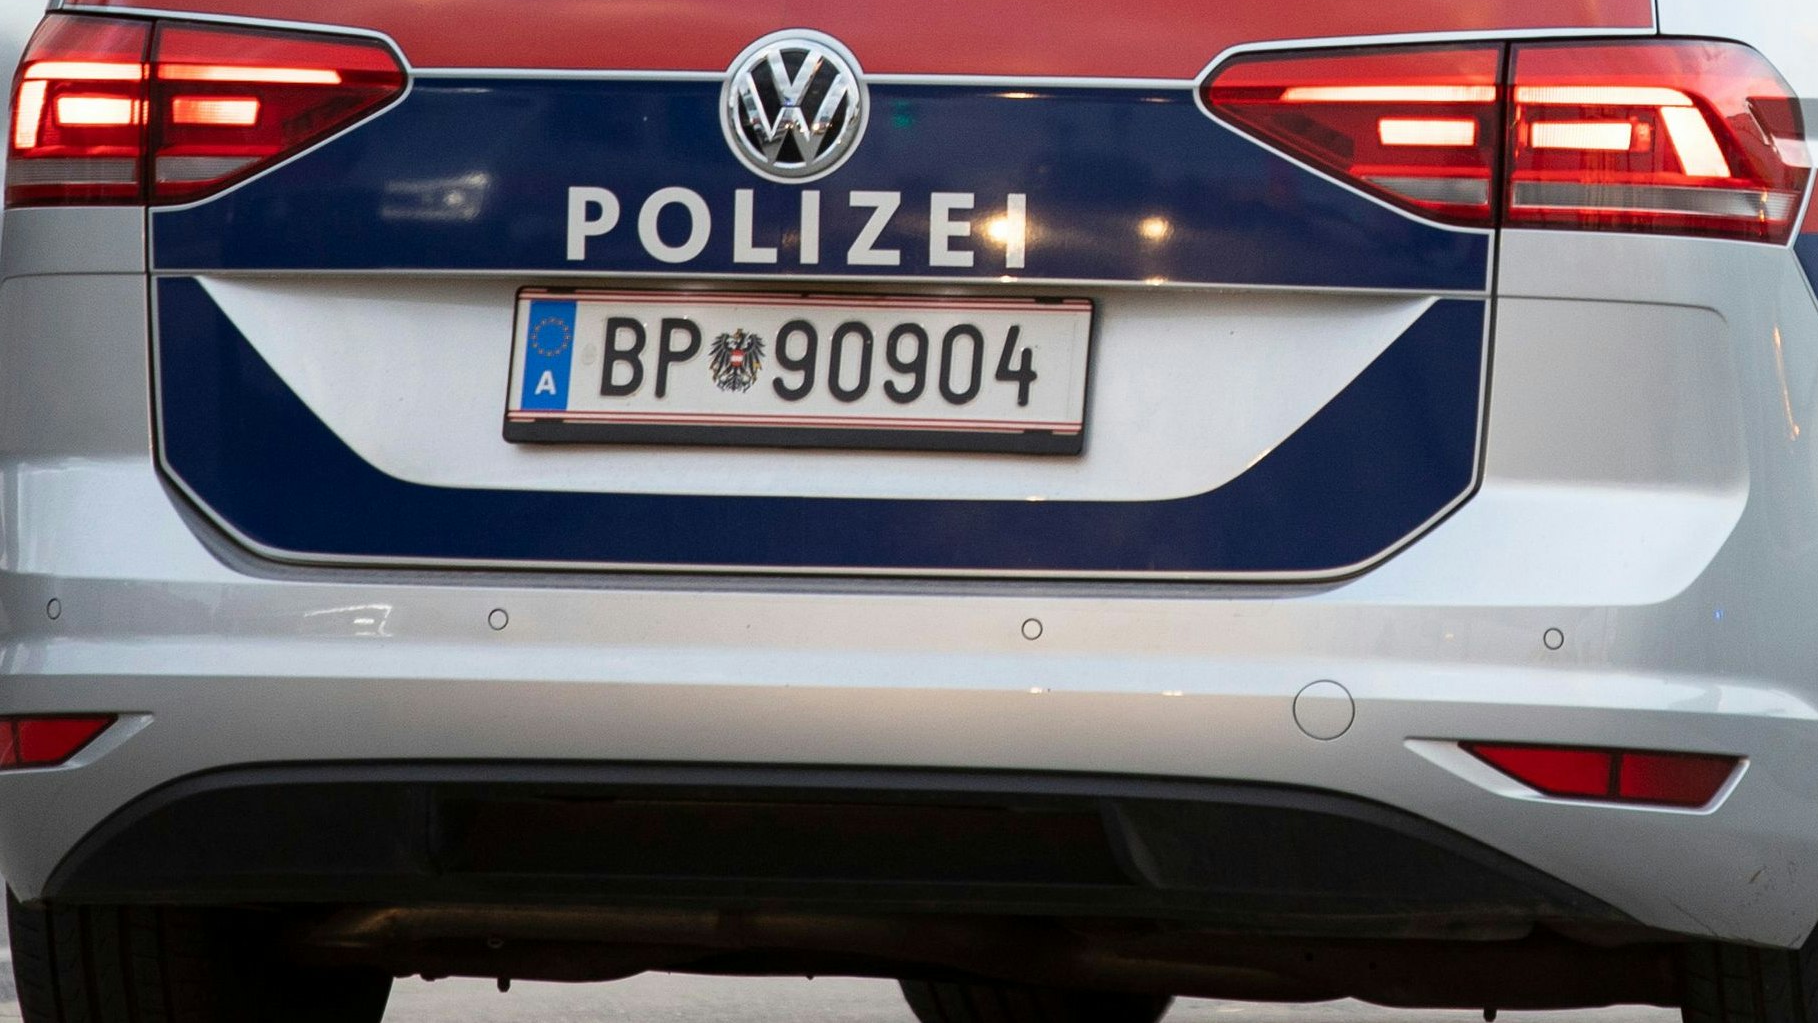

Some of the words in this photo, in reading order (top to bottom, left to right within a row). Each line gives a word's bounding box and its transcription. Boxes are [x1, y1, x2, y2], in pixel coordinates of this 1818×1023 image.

[566, 186, 1027, 270] POLIZEI
[534, 370, 557, 395] A
[600, 317, 702, 399] BP
[772, 319, 1038, 408] 90904
